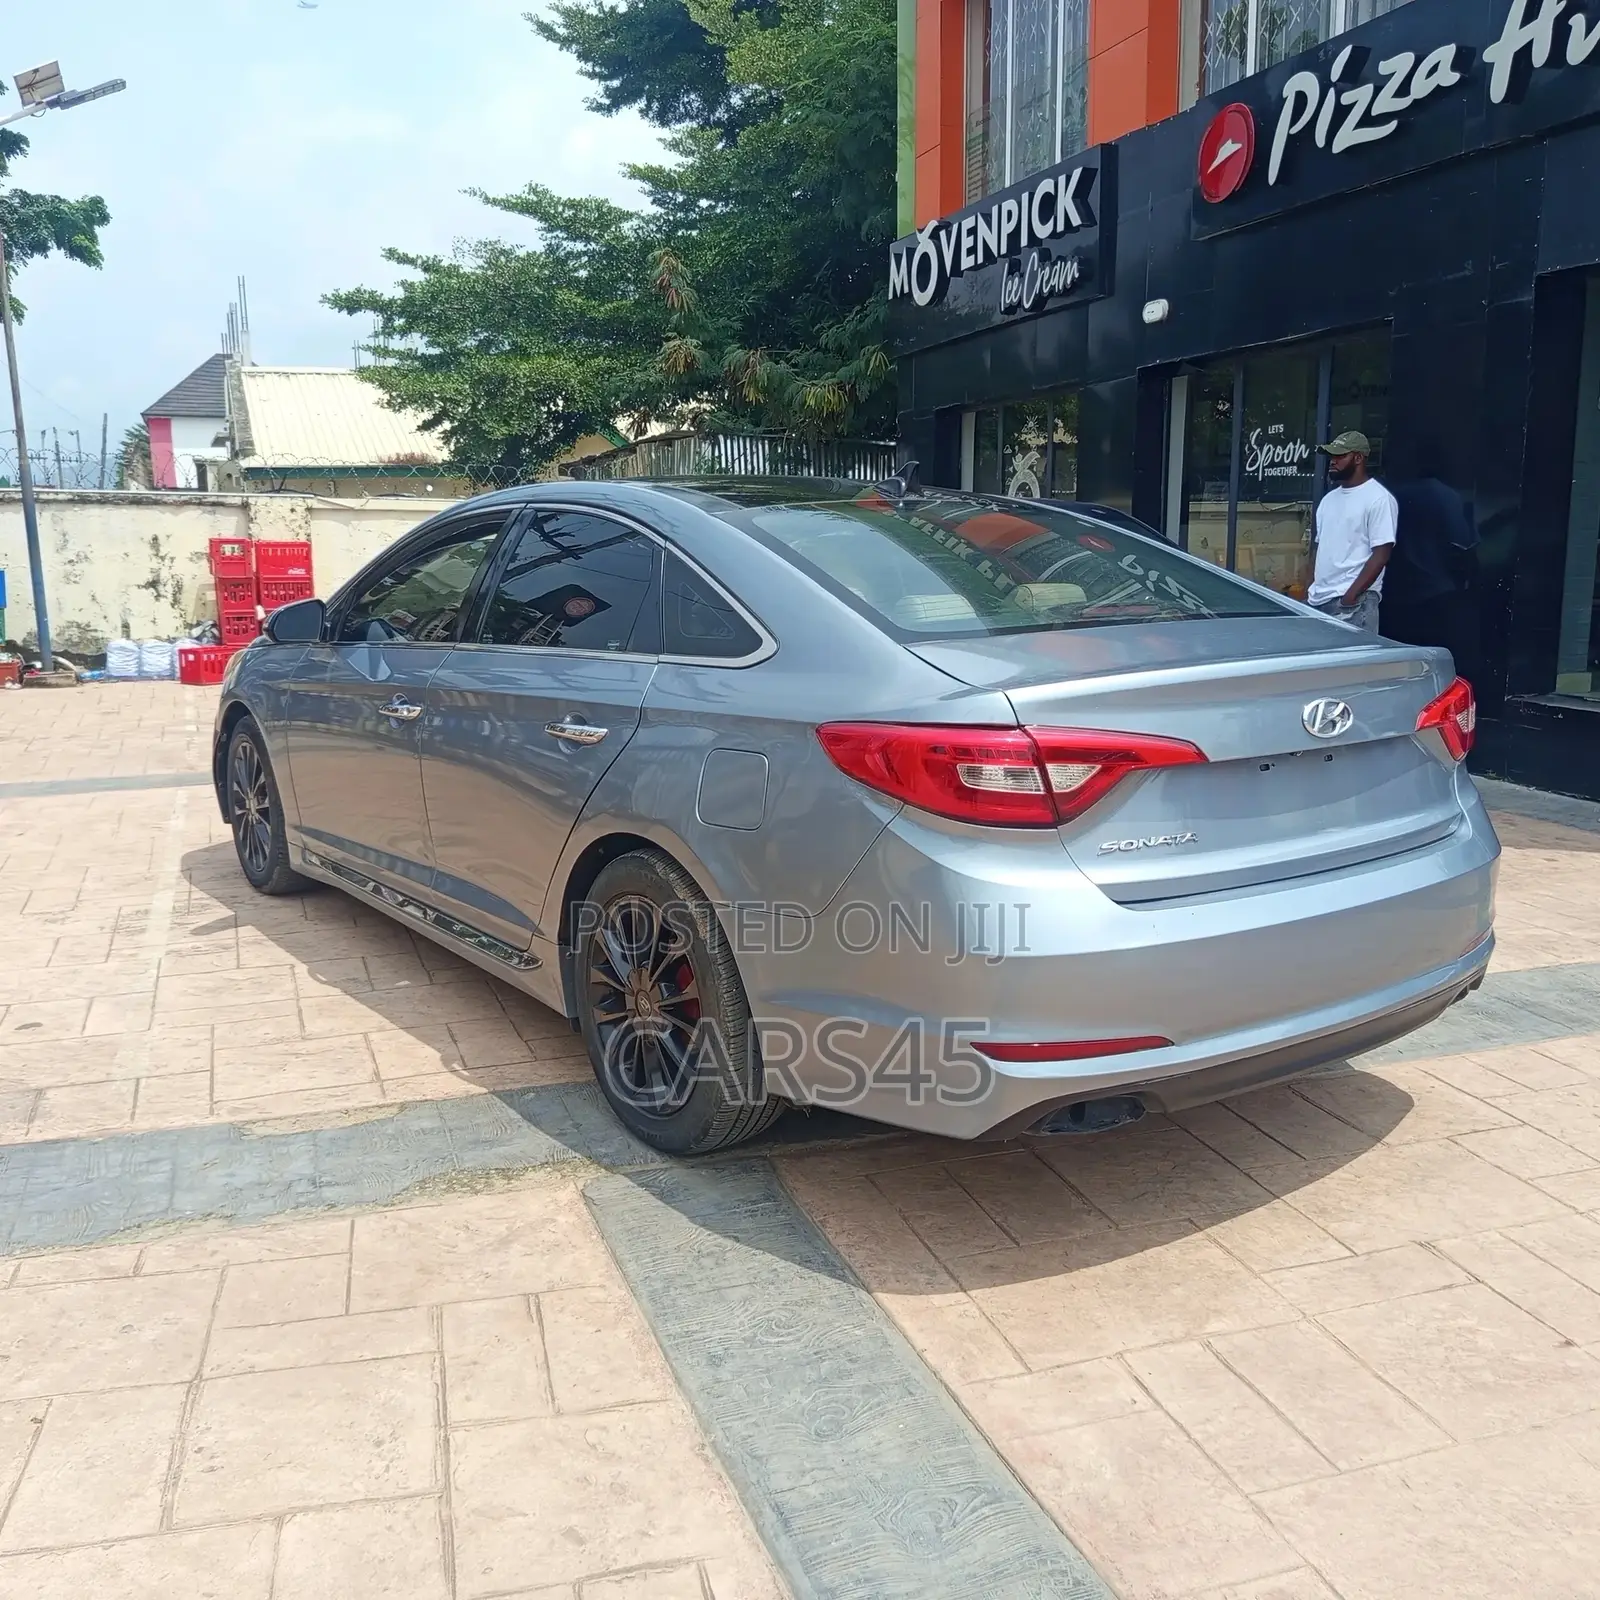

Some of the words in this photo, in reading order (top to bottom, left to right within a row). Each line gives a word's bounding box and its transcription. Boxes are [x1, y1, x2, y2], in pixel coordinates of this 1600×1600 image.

[1268, 44, 1460, 186] Pizza
[1001, 262, 1023, 313] Ice
[1023, 251, 1079, 310] Cream
[1245, 428, 1310, 481] Spoon
[1264, 466, 1298, 476] TOGETHER
[1097, 831, 1199, 856] SONATA
